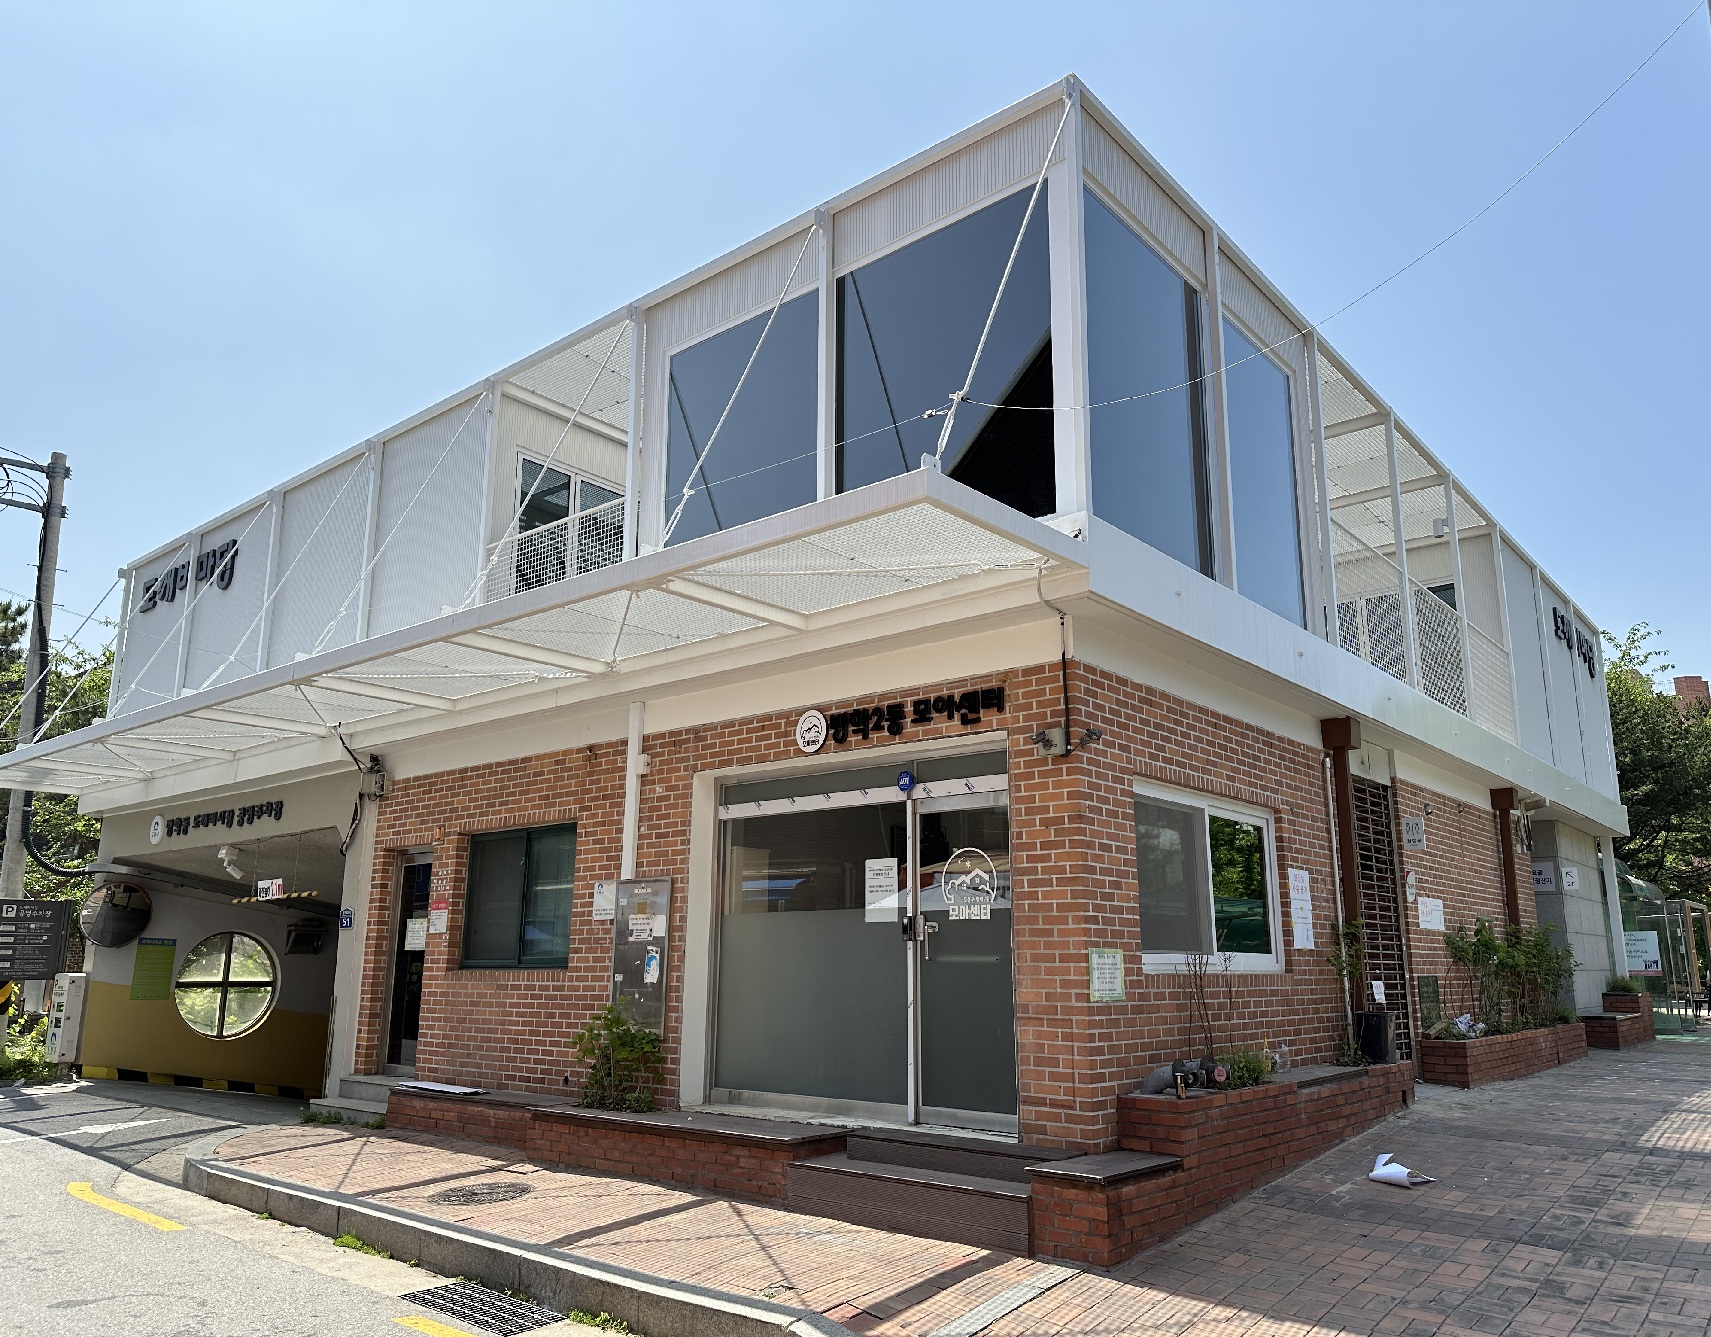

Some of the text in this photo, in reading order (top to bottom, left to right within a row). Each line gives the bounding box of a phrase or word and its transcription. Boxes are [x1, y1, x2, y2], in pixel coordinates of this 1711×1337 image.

[829, 687, 1004, 744] 방학2동 모아센터
[949, 904, 991, 920] 모아센터
[342, 917, 350, 927] 51
